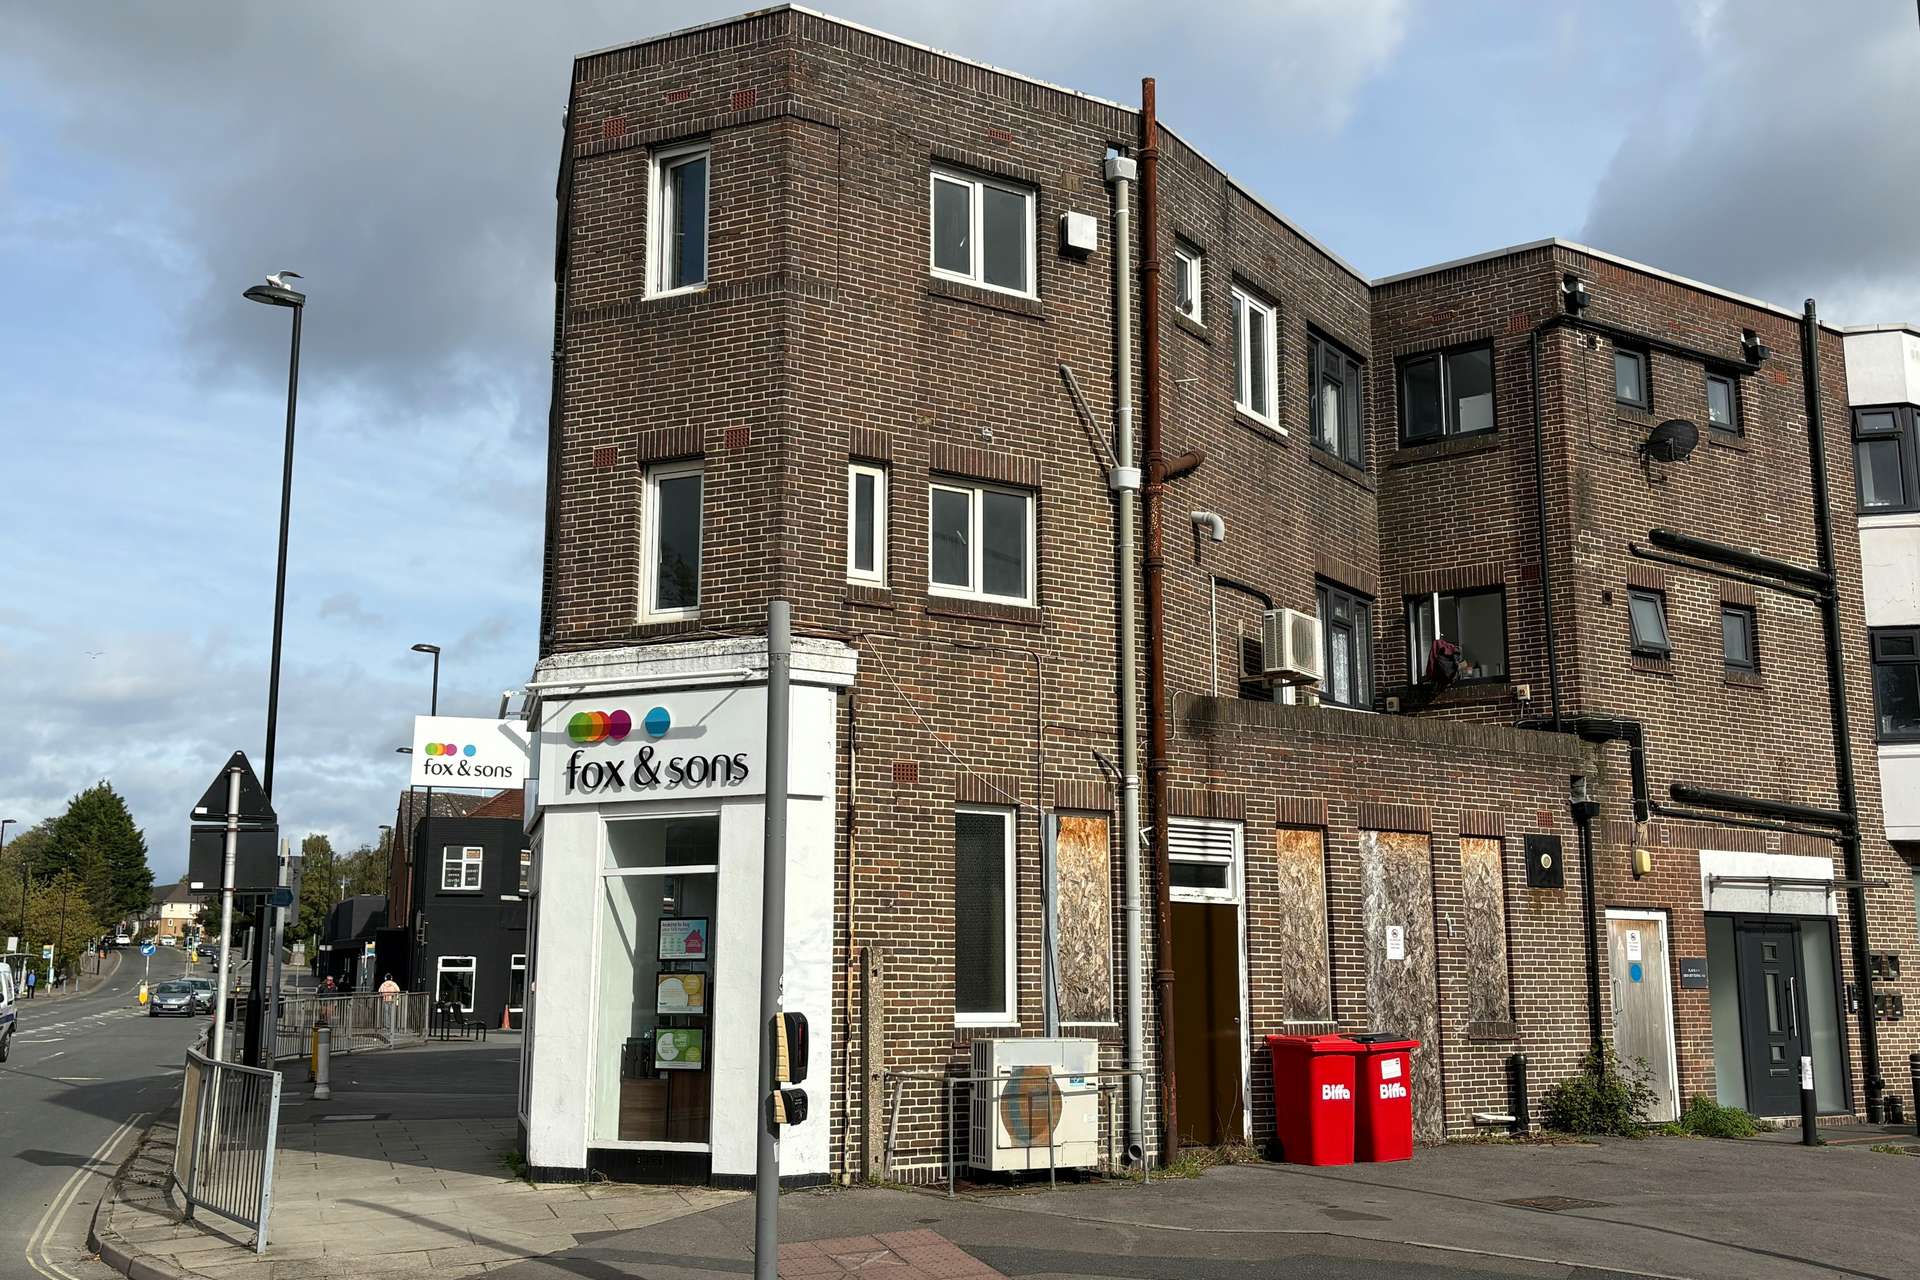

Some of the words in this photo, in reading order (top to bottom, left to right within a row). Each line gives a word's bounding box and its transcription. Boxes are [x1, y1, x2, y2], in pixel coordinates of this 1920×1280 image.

[424, 758, 454, 776] fox
[457, 759, 471, 777] &
[474, 765, 513, 778] sons
[566, 750, 626, 789] fox
[634, 745, 661, 786] &
[669, 752, 749, 784] sons
[1322, 1084, 1350, 1100] Biffa
[1380, 1082, 1407, 1099] Biffa
